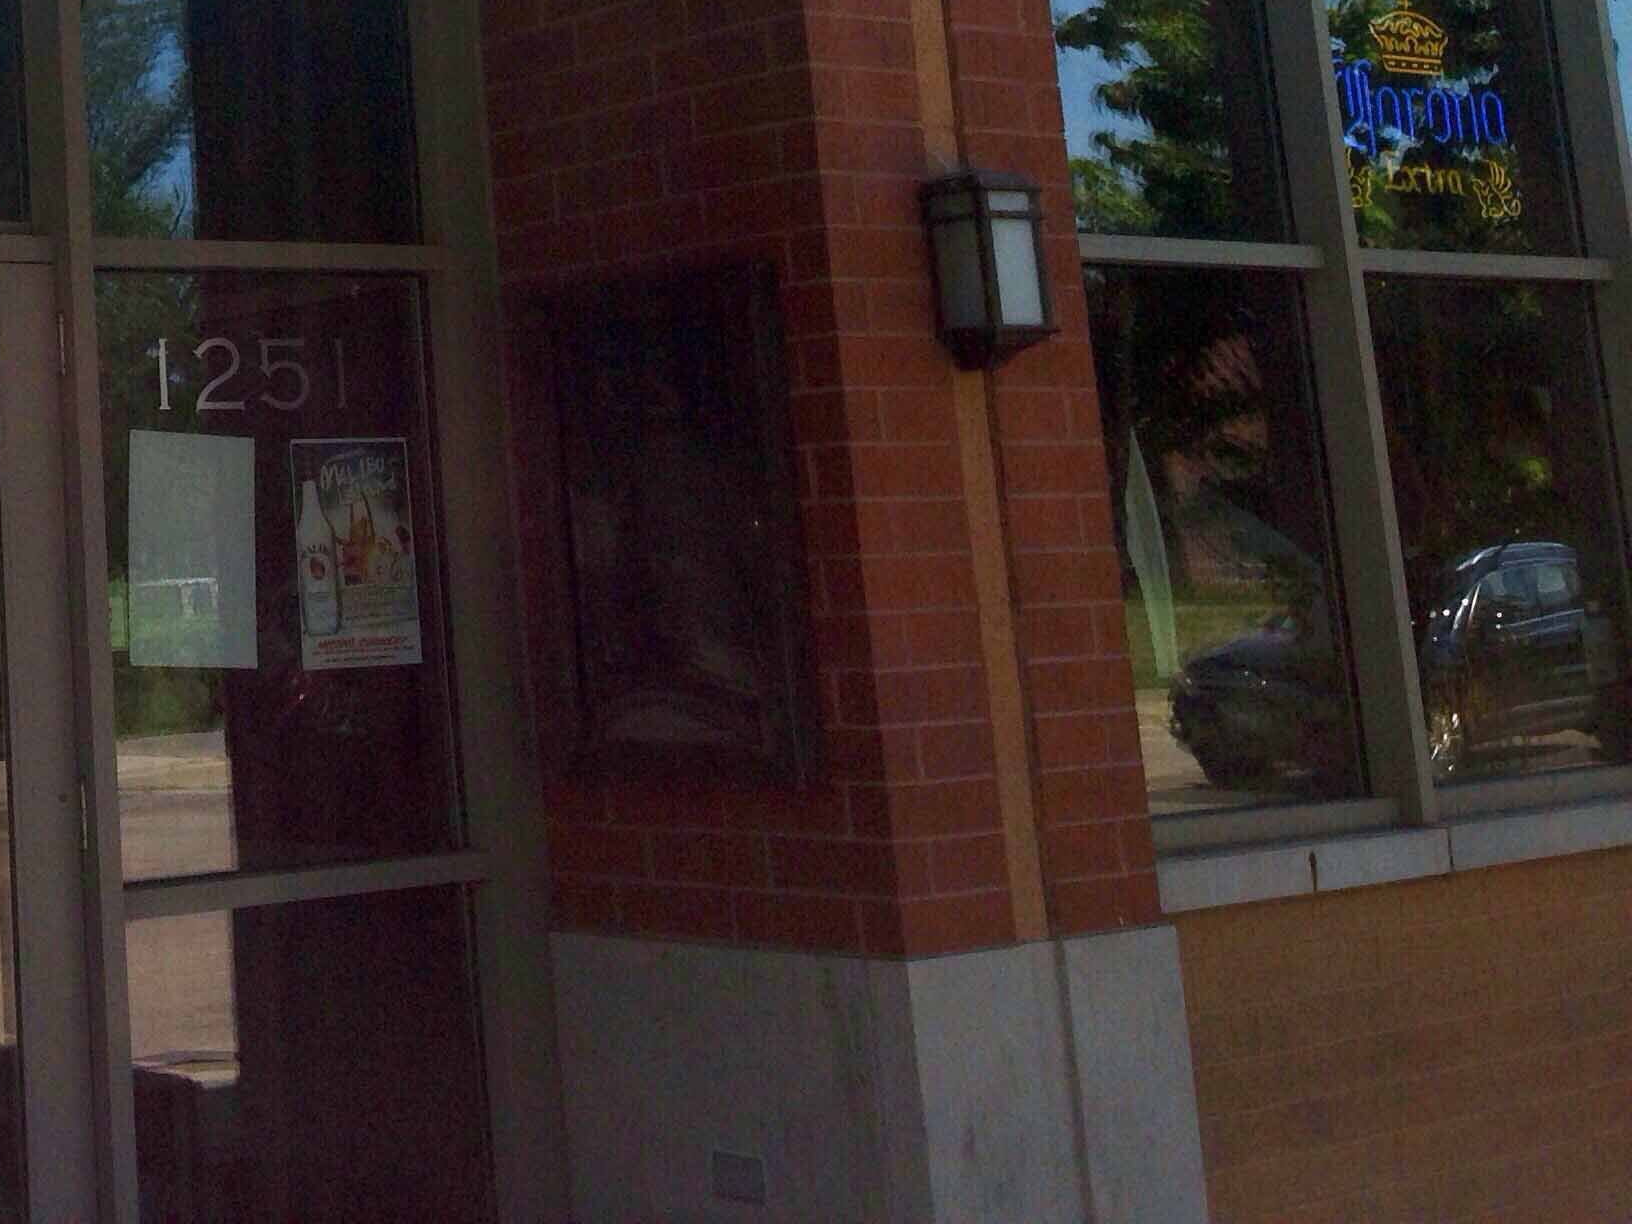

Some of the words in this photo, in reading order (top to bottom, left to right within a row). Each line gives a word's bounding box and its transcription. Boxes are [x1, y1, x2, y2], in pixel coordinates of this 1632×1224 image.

[1333, 59, 1509, 159] Corona
[1383, 160, 1465, 196] Extra
[156, 336, 348, 413] 1251
